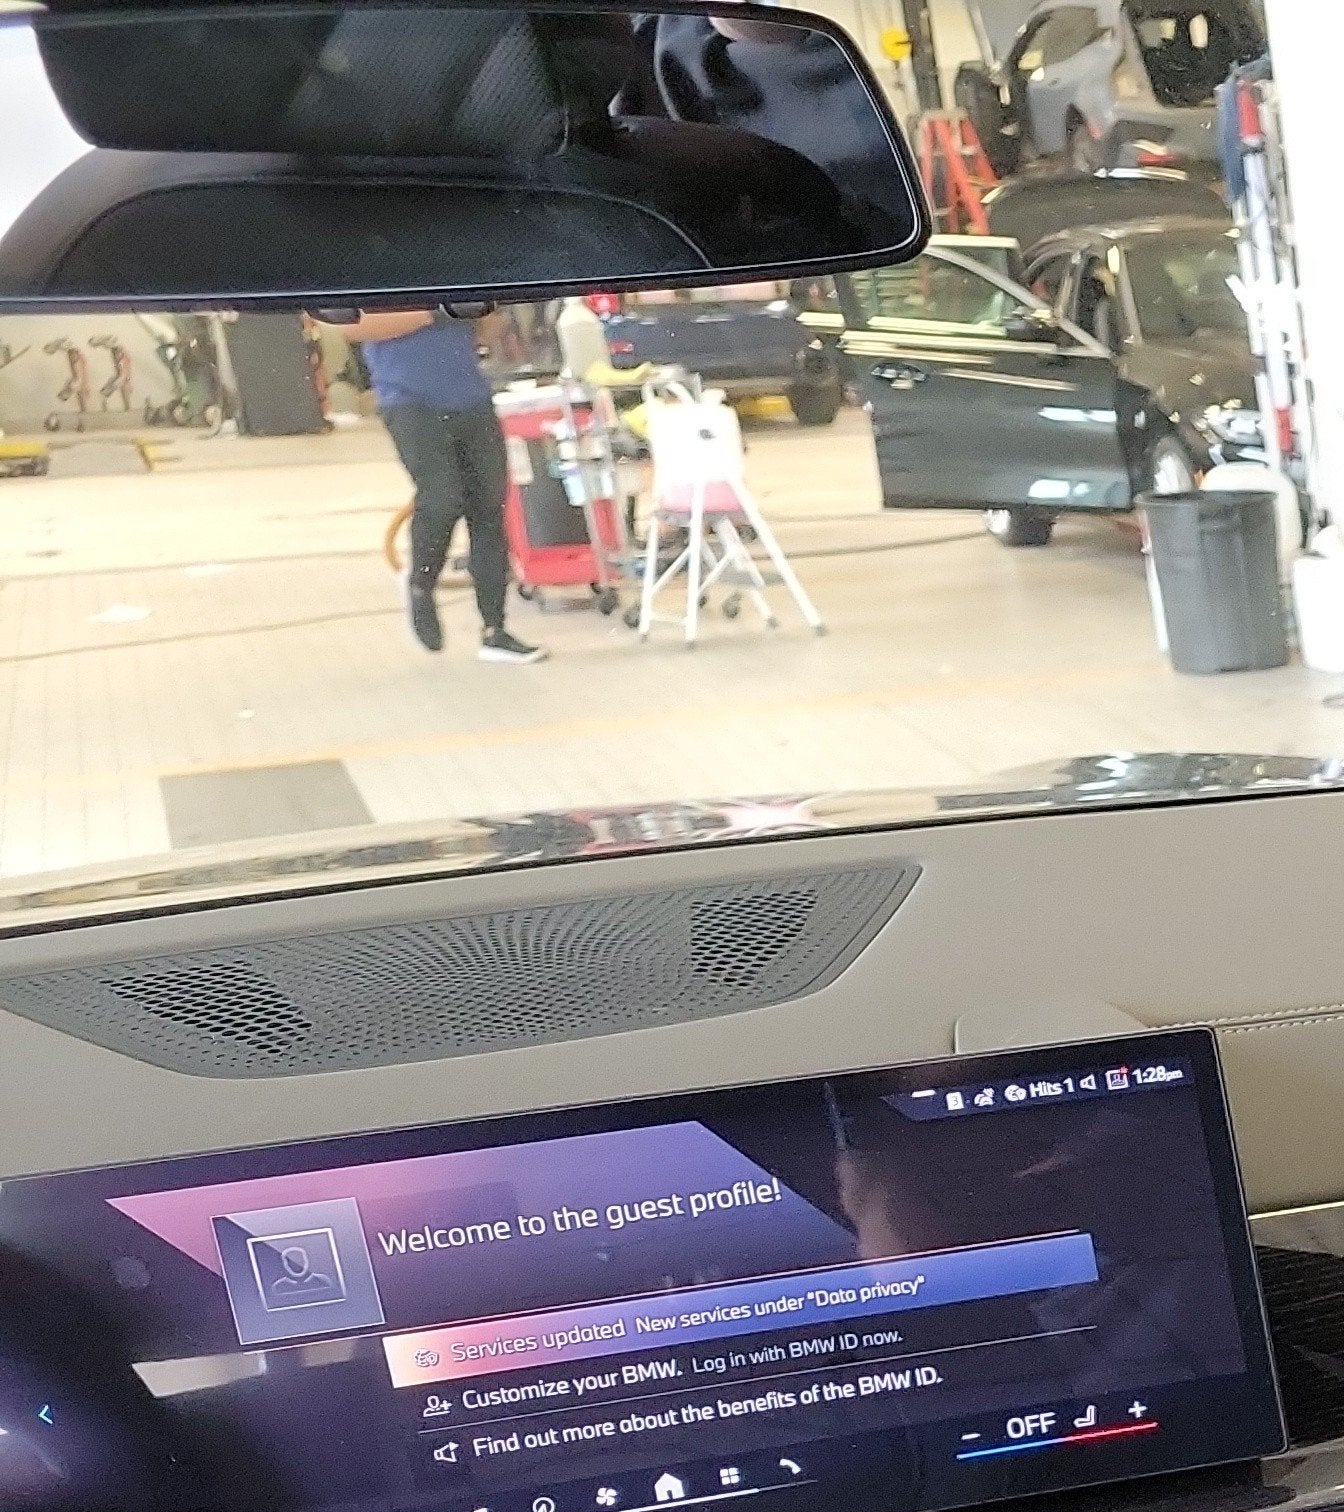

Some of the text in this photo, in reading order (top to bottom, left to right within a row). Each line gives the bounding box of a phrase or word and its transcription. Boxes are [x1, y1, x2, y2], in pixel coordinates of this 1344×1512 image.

[1029, 1081, 1062, 1098] Hits
[378, 1177, 782, 1256] Welcome to the guest profile!
[636, 1314, 676, 1333] New
[680, 1306, 751, 1328] services
[755, 1296, 804, 1316] under
[450, 1319, 626, 1362] Services updated
[693, 1330, 903, 1374] Log in with BMW ID now.
[462, 1359, 683, 1410] Customize your BMW.
[473, 1366, 943, 1456] Find out more about the benefits of the BMW ID.
[1006, 1412, 1056, 1438] OFF
